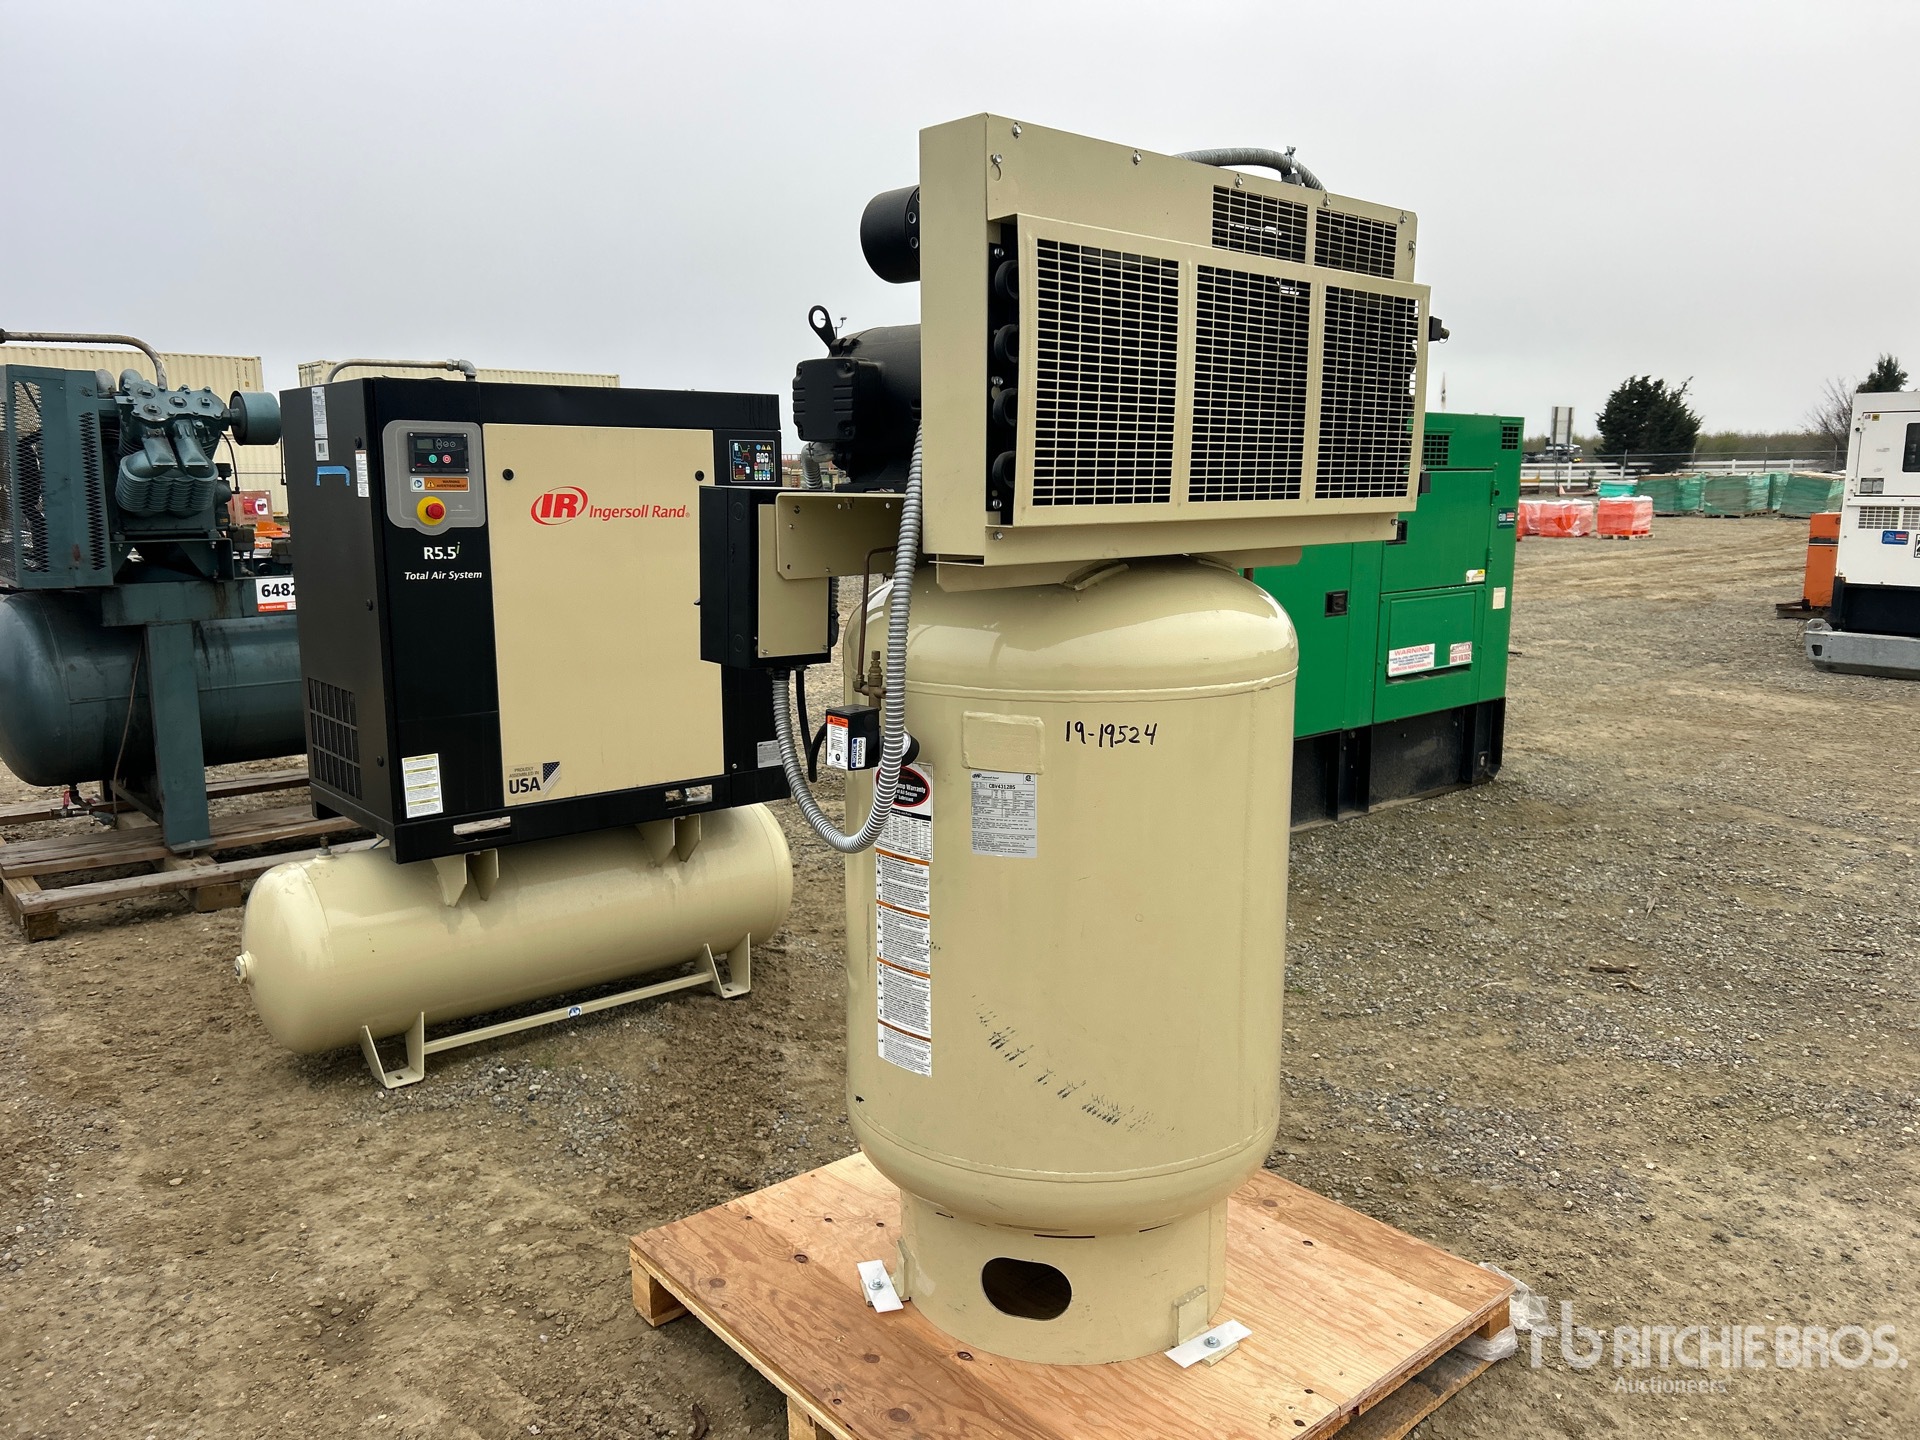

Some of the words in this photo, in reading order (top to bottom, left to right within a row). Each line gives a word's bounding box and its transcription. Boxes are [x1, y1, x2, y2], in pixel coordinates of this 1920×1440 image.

[541, 493, 579, 518] IR
[589, 504, 649, 522] Ingersoll
[404, 571, 430, 581] Total
[431, 571, 447, 580] Air
[448, 570, 483, 581] System
[1394, 645, 1430, 656] WARNING
[1065, 721, 1158, 748] 19-19524
[509, 777, 541, 794] USA
